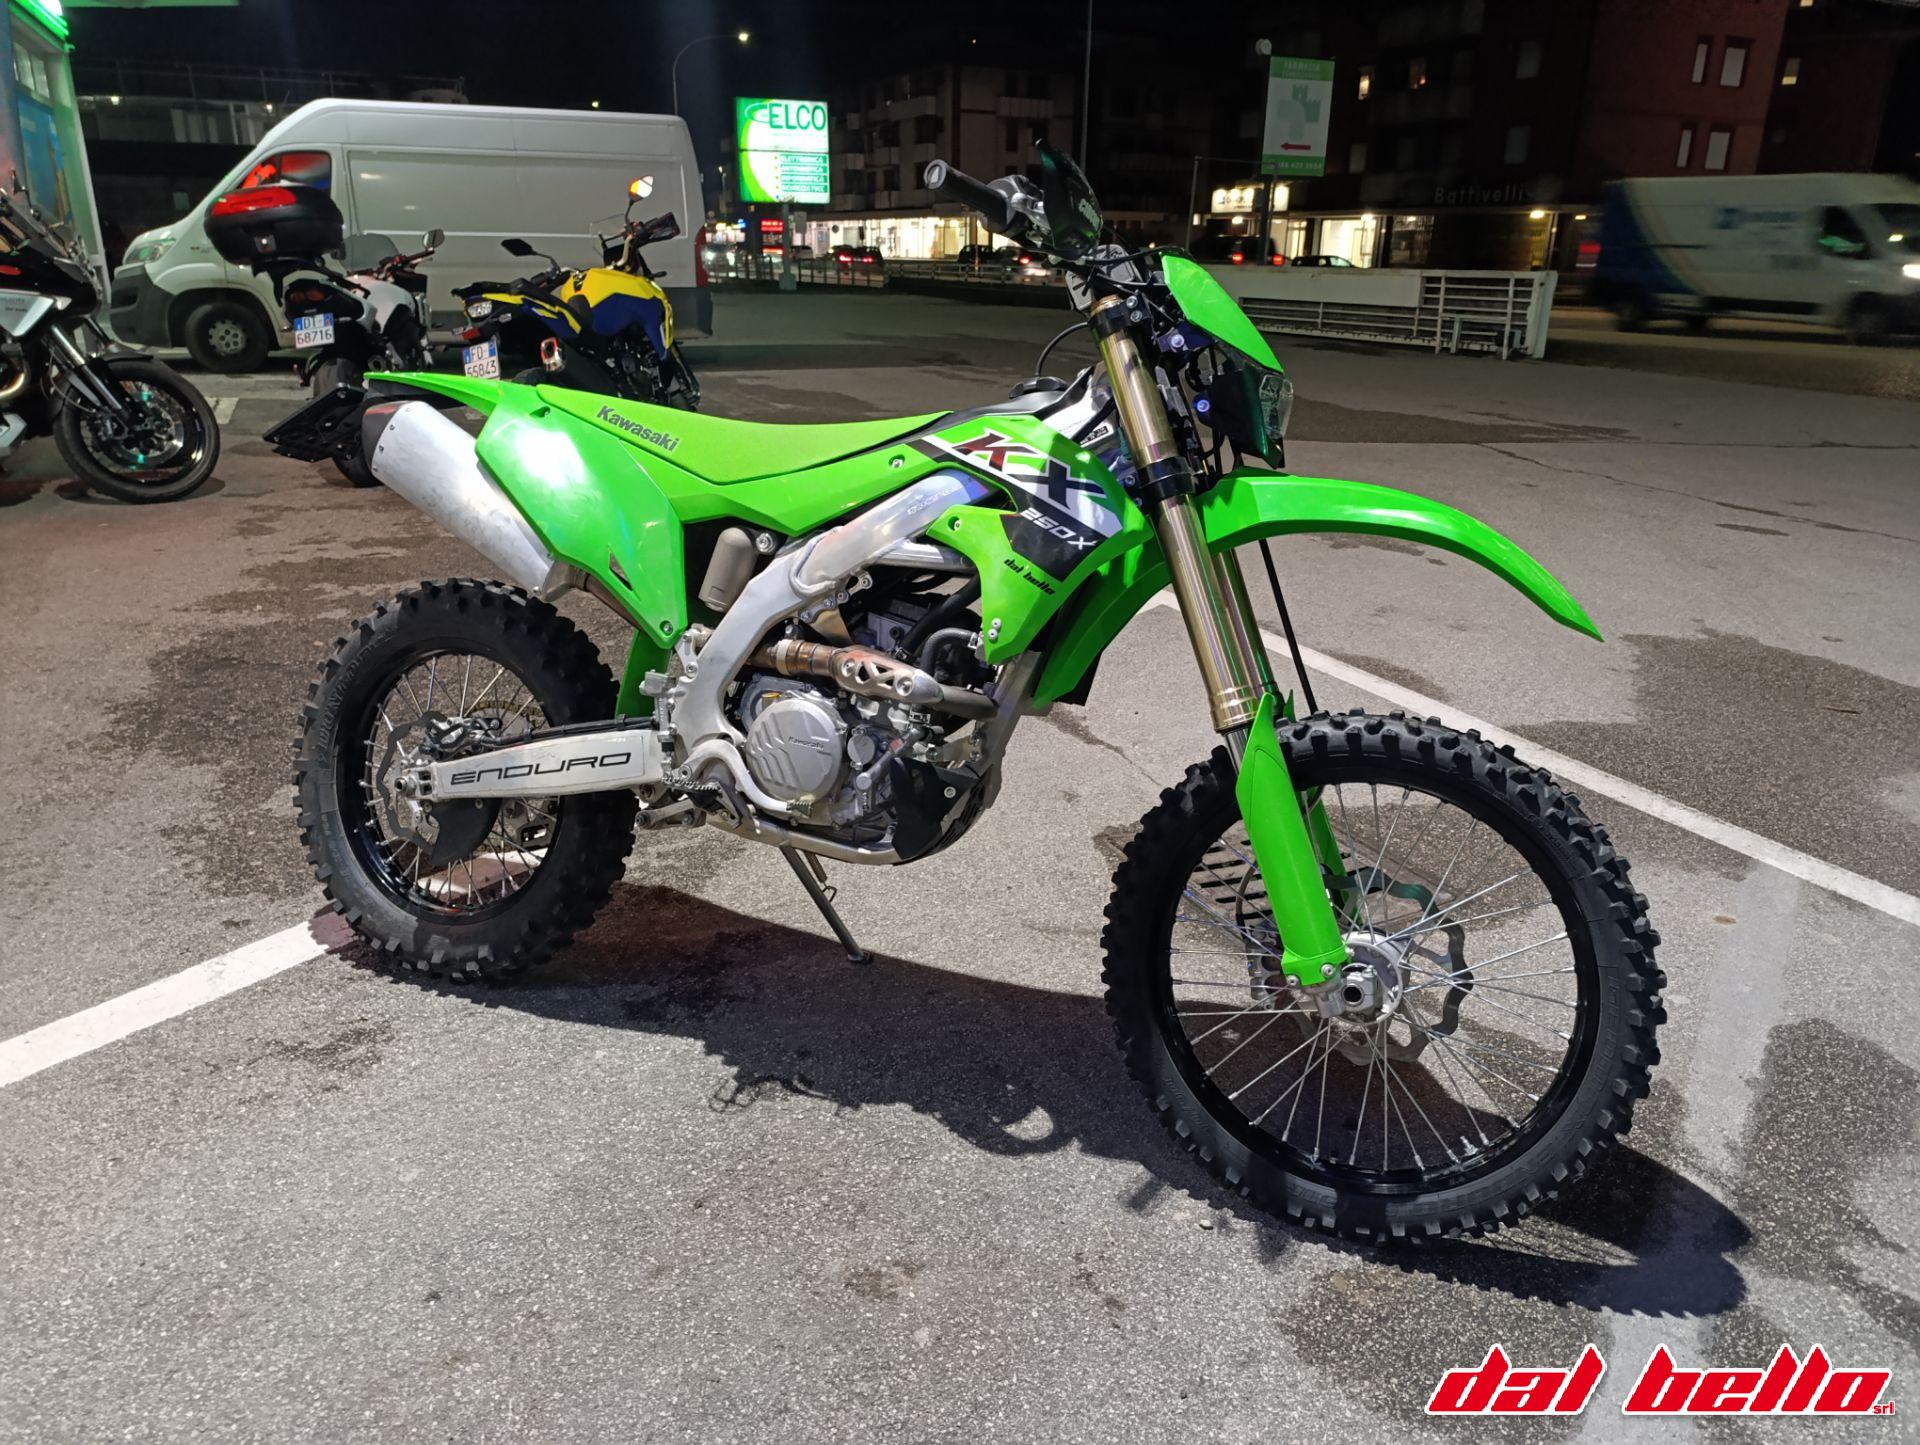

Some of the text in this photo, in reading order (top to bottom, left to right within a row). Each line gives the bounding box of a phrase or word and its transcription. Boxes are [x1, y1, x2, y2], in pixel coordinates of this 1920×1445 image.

[768, 103, 827, 131] ELCO
[297, 329, 333, 345] 68716
[597, 405, 680, 452] Kawasaki
[952, 431, 1108, 512] KX
[1003, 558, 1056, 596] dal bello
[450, 752, 632, 786] ENDURO
